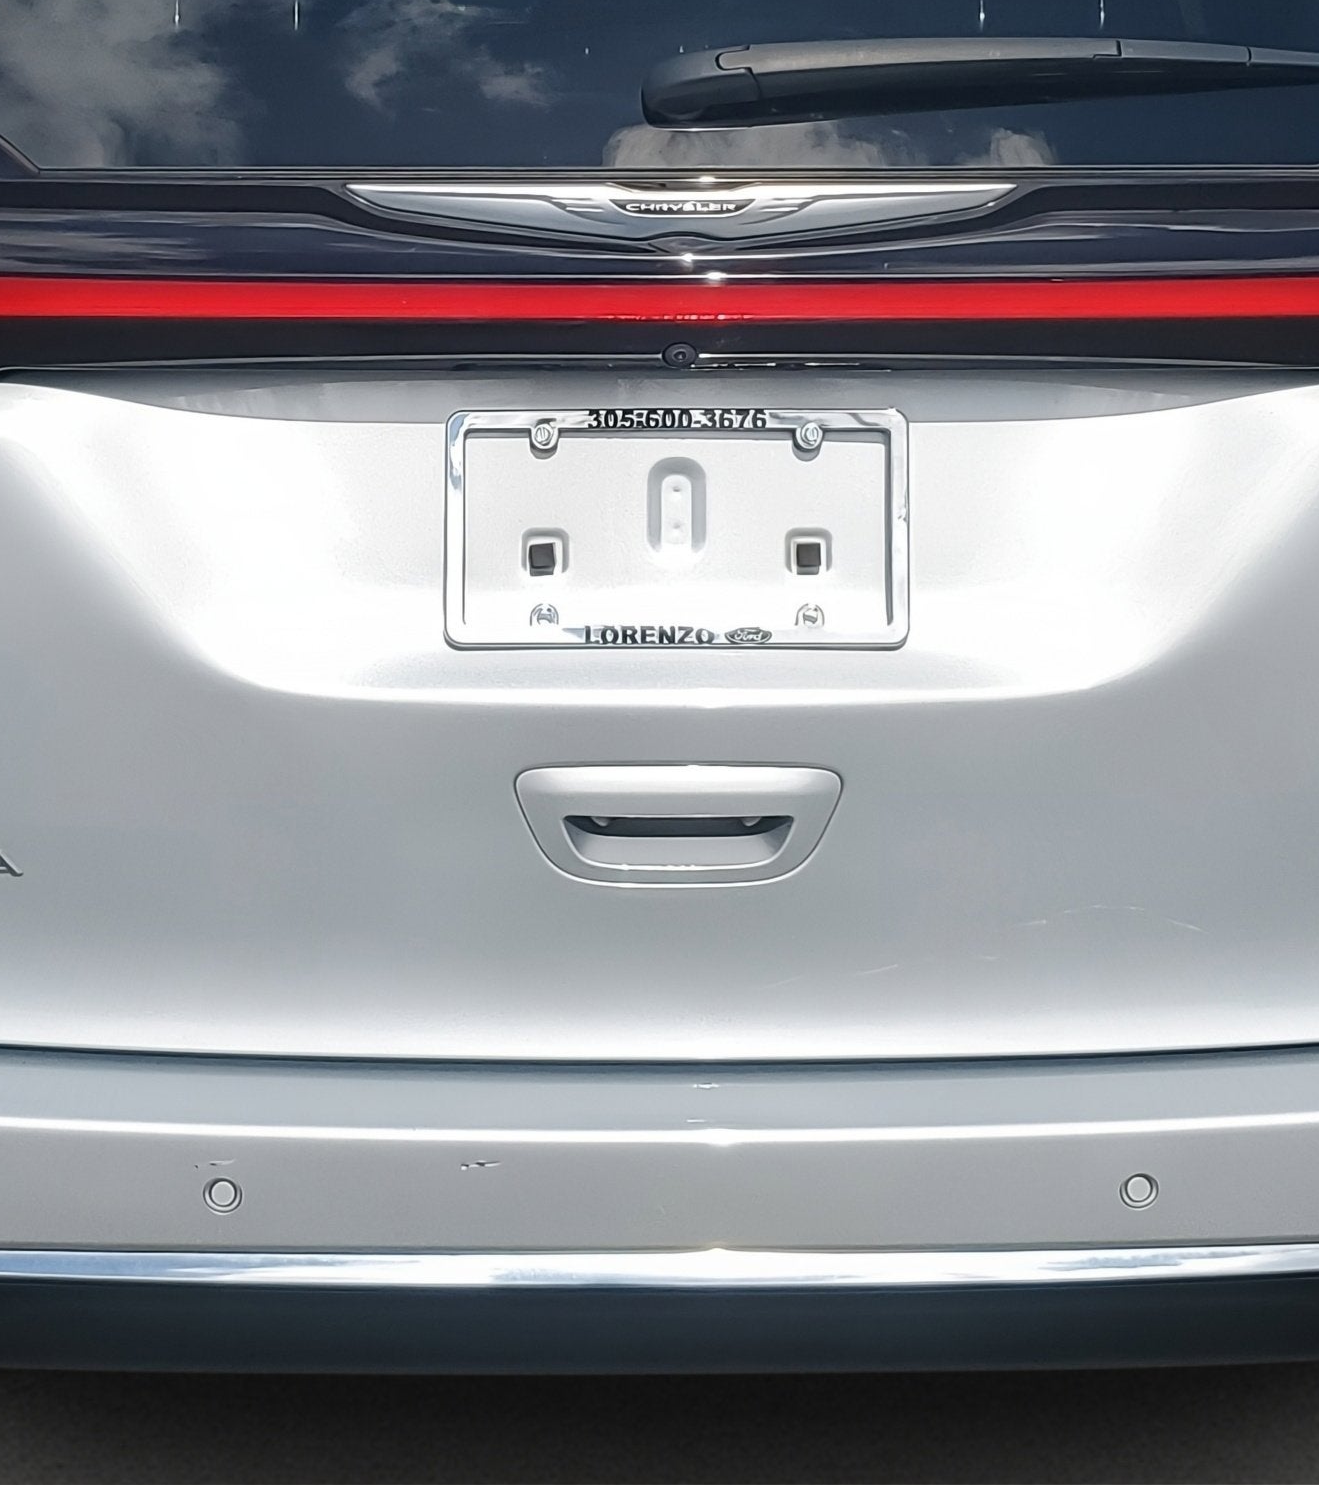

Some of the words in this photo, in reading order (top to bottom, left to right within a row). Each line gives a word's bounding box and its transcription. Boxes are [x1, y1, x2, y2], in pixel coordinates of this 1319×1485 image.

[625, 201, 737, 212] CHRYSLER
[586, 409, 767, 429] 305-600-3676
[584, 625, 715, 645] LORENZO
